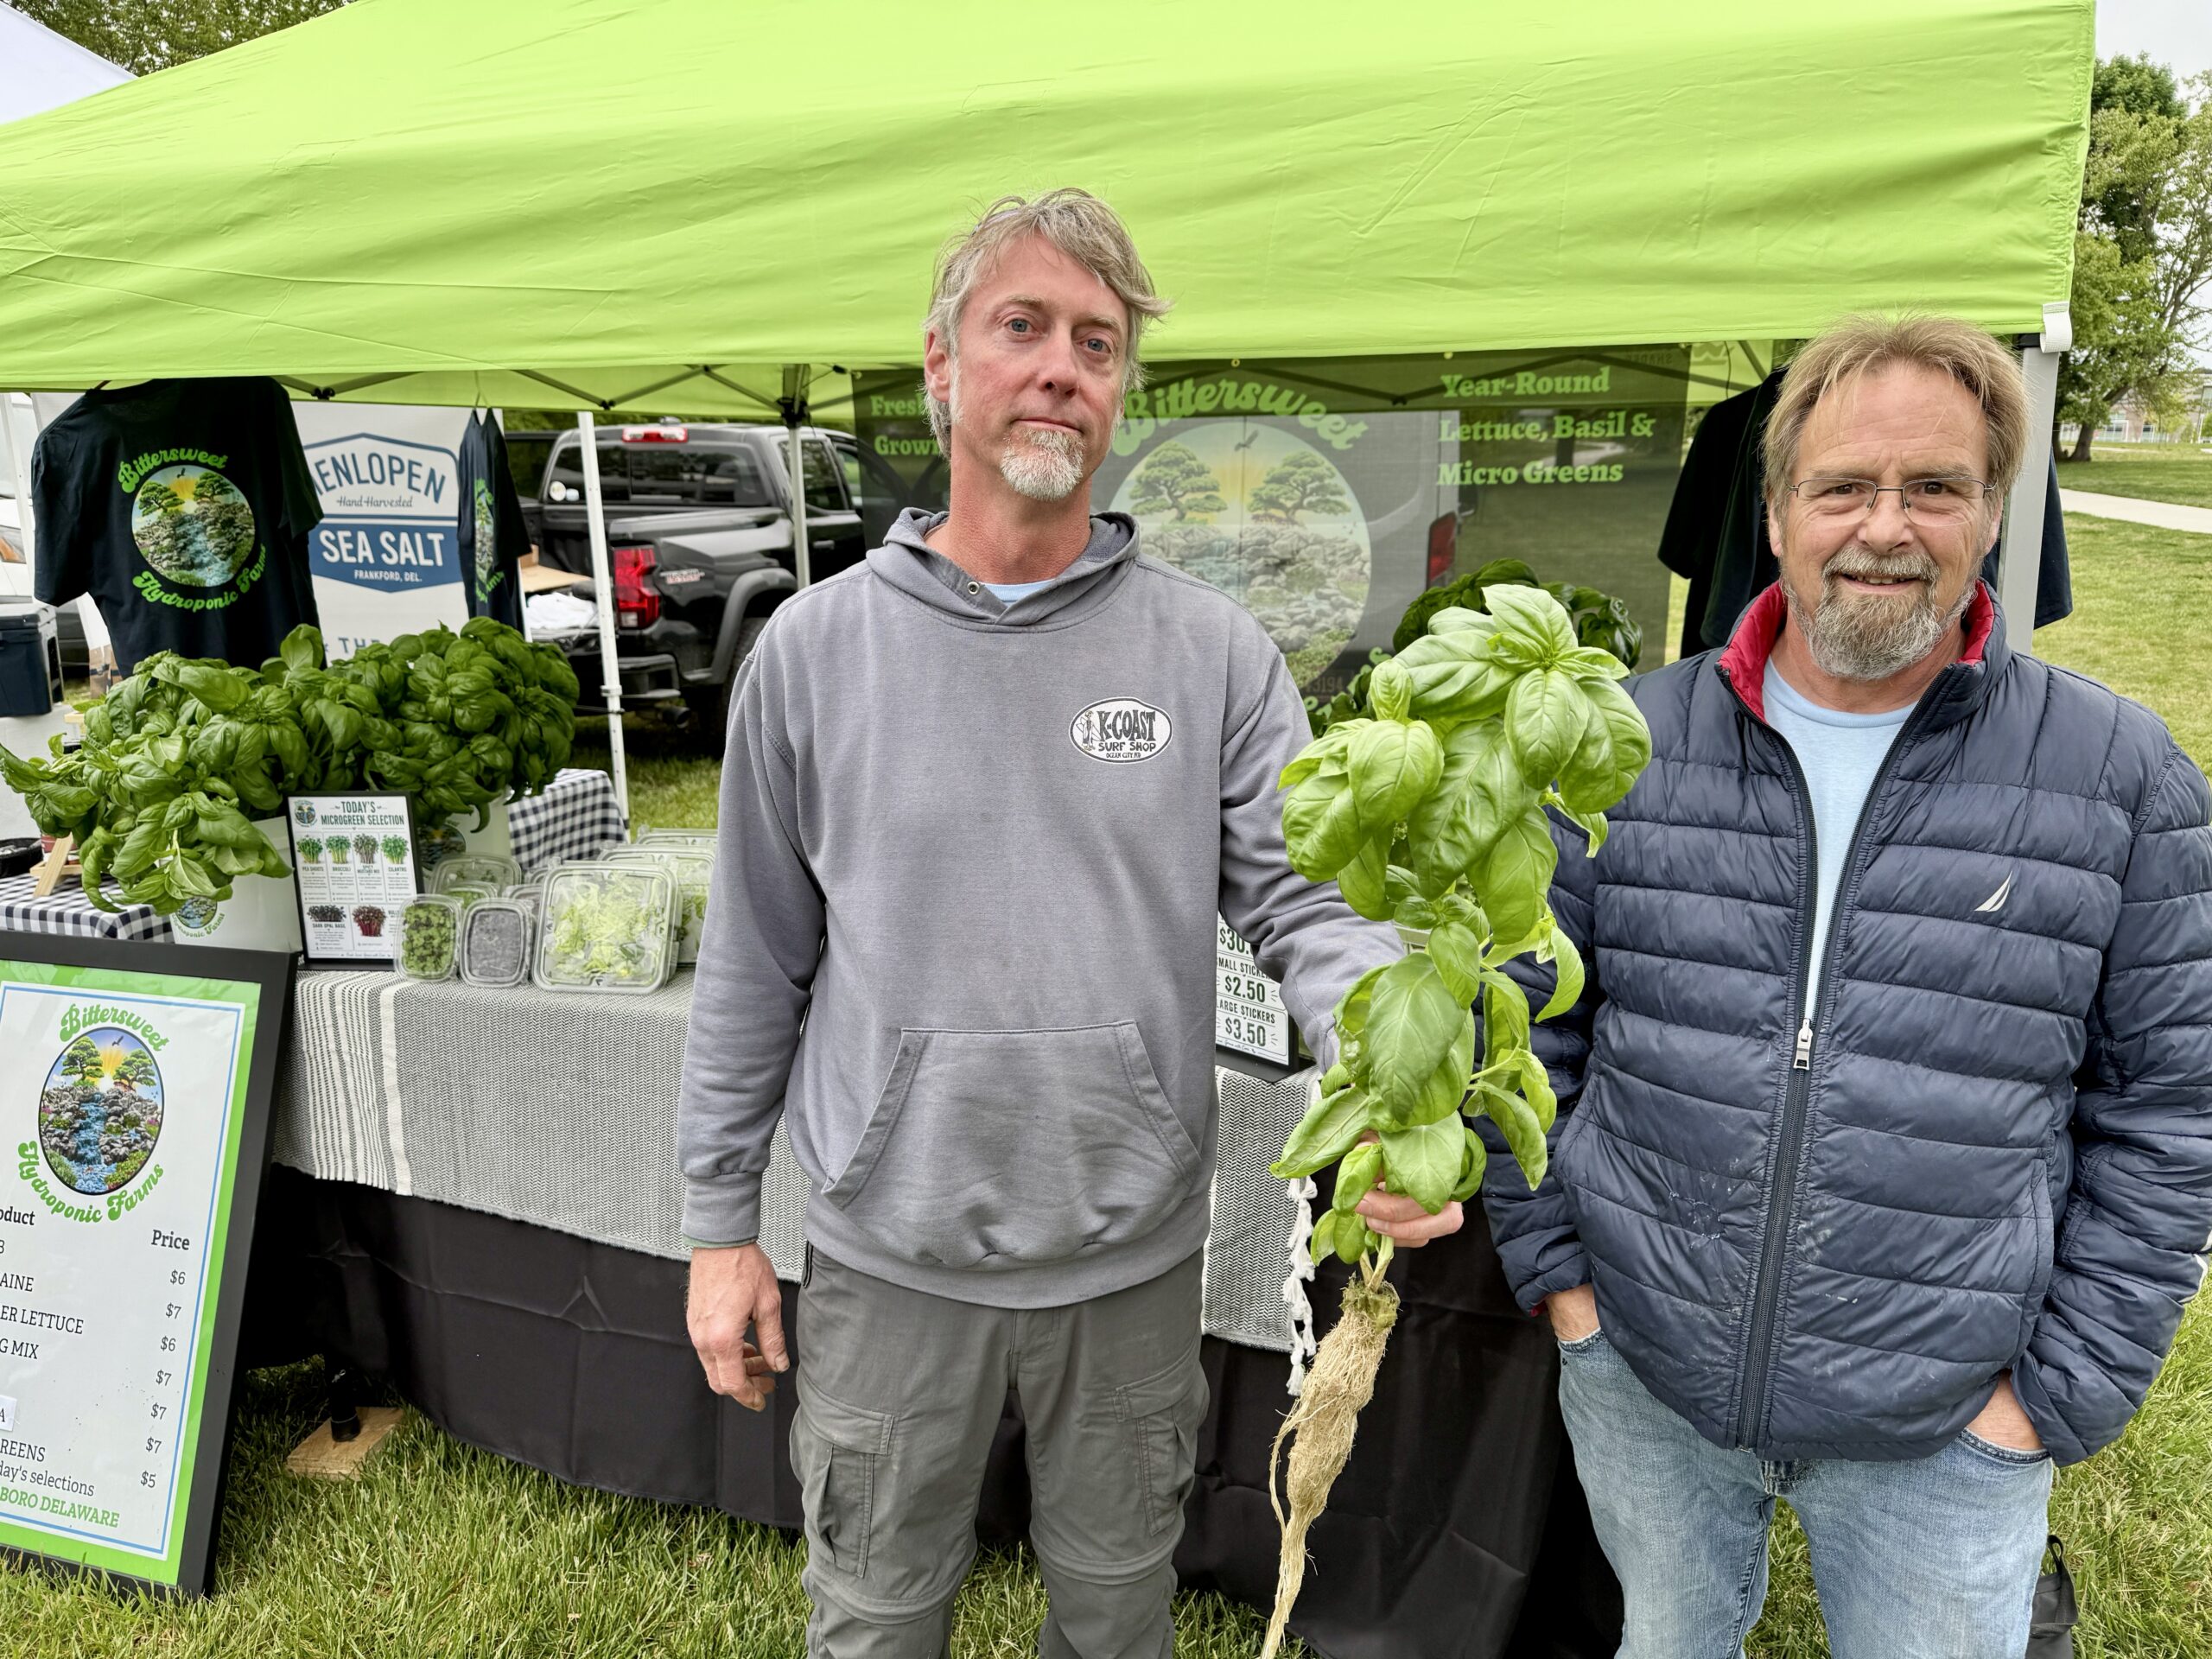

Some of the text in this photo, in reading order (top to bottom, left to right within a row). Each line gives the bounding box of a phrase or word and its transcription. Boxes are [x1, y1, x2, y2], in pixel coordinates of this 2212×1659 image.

[1440, 366, 1611, 397] Year-Round
[1111, 377, 1370, 456] Bittersweet
[1438, 410, 1657, 443] Lettuce, Basil &
[118, 448, 229, 493] Bittersweet
[1436, 460, 1624, 486] Micro Greens
[319, 530, 445, 567] SEA SALT
[132, 543, 266, 613] Hydroponic Farms
[354, 569, 423, 582] FRANKFORD, DEL.
[1096, 709, 1156, 741] K-COAST
[1098, 742, 1156, 752] SURF SHOP
[341, 801, 376, 813] TODAY'S
[321, 814, 404, 825] MICROGREEN SELECTION
[1217, 957, 1237, 971] MALL
[1224, 974, 1265, 1003] $2.50
[1241, 1005, 1275, 1024] STICKERS
[59, 1003, 171, 1052] Bittersweet
[1225, 1017, 1266, 1046] $3.50
[17, 1140, 164, 1224] Hydroponic Farms
[151, 1229, 190, 1251] Price
[169, 1269, 186, 1286] $6
[20, 1309, 84, 1335] LETTUCE
[165, 1302, 181, 1319] $7
[11, 1340, 40, 1359] MIX
[160, 1335, 176, 1351] $6
[156, 1369, 172, 1386] $7
[150, 1402, 167, 1421] $7
[145, 1436, 162, 1454] $7
[29, 1470, 95, 1497] selections
[140, 1471, 156, 1490] $5
[39, 1496, 120, 1528] DELAWARE
